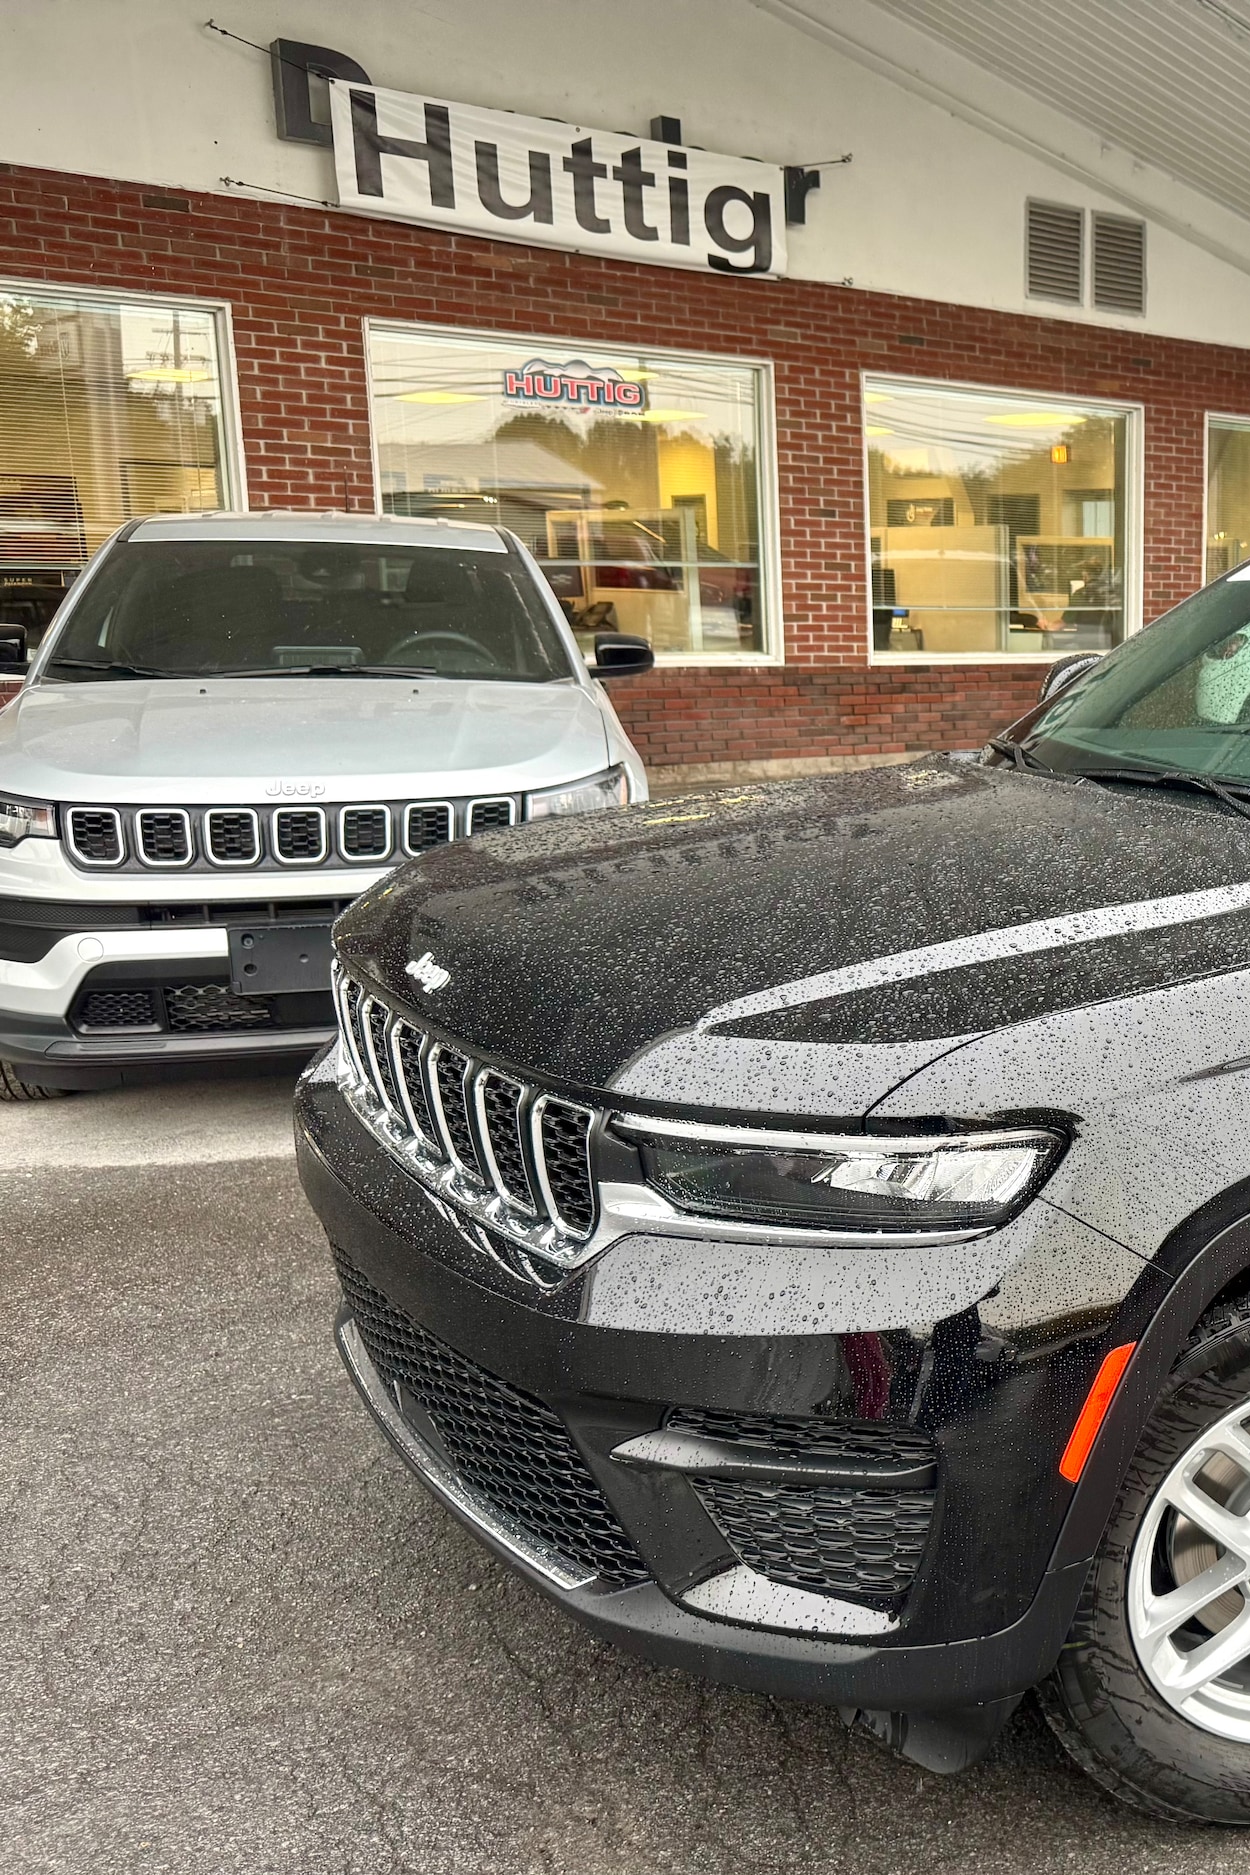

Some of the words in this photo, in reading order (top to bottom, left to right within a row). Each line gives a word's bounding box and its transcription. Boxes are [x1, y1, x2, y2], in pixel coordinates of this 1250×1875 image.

[349, 89, 772, 274] Huttig
[506, 373, 641, 404] HUTTIG
[265, 780, 325, 799] Jeep
